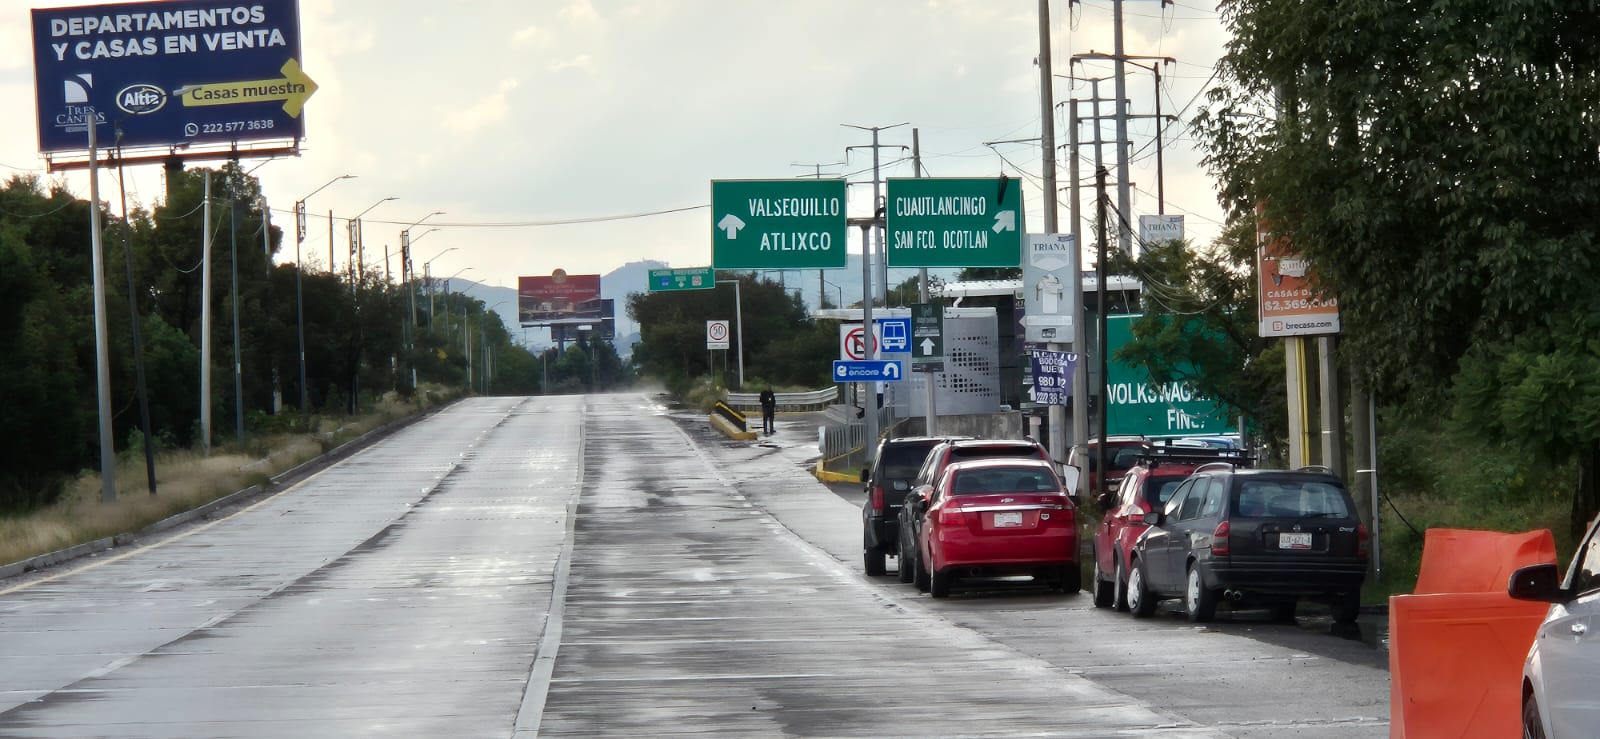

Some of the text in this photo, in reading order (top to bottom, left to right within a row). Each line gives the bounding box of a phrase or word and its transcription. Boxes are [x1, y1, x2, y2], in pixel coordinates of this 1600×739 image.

[51, 6, 265, 37] DEPARTAMENTOS
[52, 28, 287, 61] Y CASAS EN VENTA
[192, 82, 306, 101] Casas muestra
[65, 105, 95, 115] TRES
[203, 119, 274, 133] 222 577 3638
[749, 197, 840, 217] VALSEQUILLO
[896, 196, 986, 217] CUAUTLANCINGO
[1147, 223, 1178, 231] TRIANA
[760, 232, 831, 252] ATLIXCO
[894, 230, 988, 250] SAN FCO. OCOTLAN
[1032, 243, 1066, 251] TRIANA
[713, 325, 723, 337] 50
